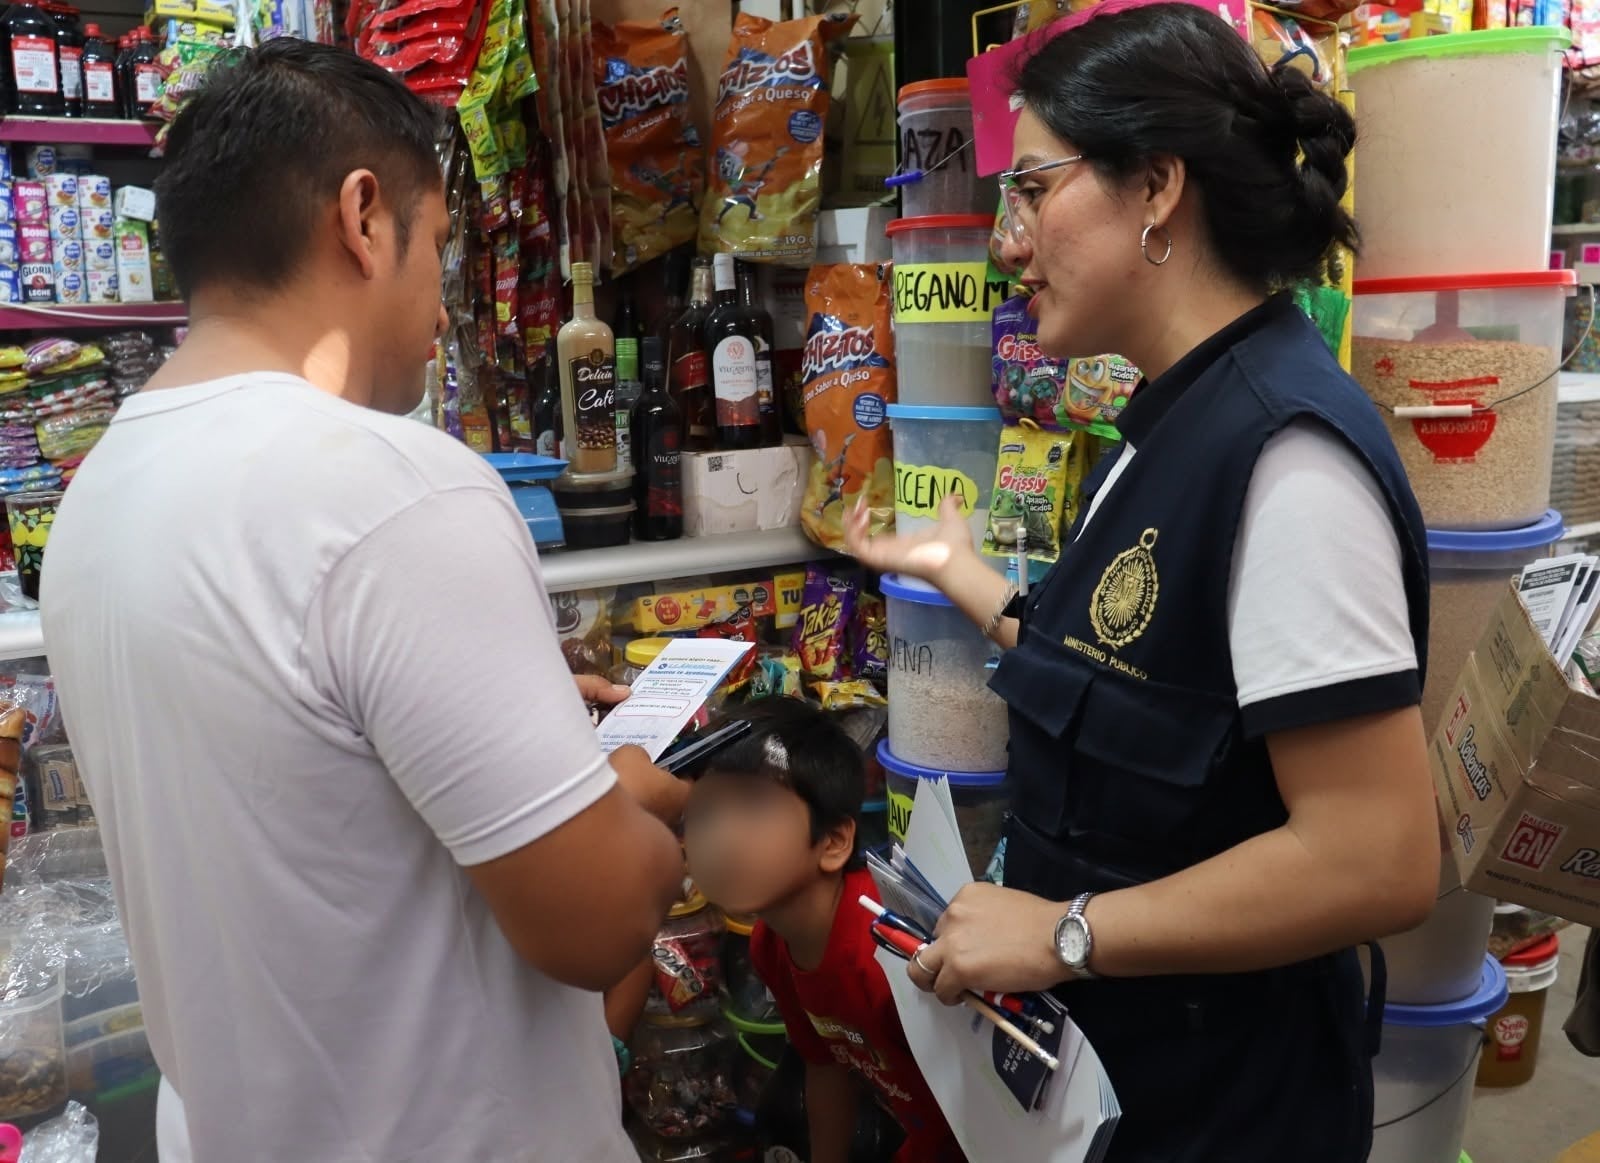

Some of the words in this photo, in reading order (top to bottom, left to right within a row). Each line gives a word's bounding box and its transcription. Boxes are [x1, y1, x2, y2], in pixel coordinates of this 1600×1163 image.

[731, 96, 755, 111] Sabor
[765, 87, 810, 103] Queso
[903, 127, 966, 173] AZA
[22, 265, 52, 277] GLORIA
[28, 288, 51, 298] LECHE
[801, 324, 876, 384] HIZITOS
[998, 334, 1045, 362] Griss
[577, 389, 615, 411] Café
[815, 378, 833, 396] Sabor
[840, 370, 871, 389] Queso
[800, 602, 843, 642] Takis
[888, 636, 933, 677] VENA
[1063, 634, 1107, 663] MINISTERIO
[1109, 655, 1148, 681] PUBLICO
[1458, 724, 1492, 800] Rellenitas
[1506, 826, 1556, 867] GN
